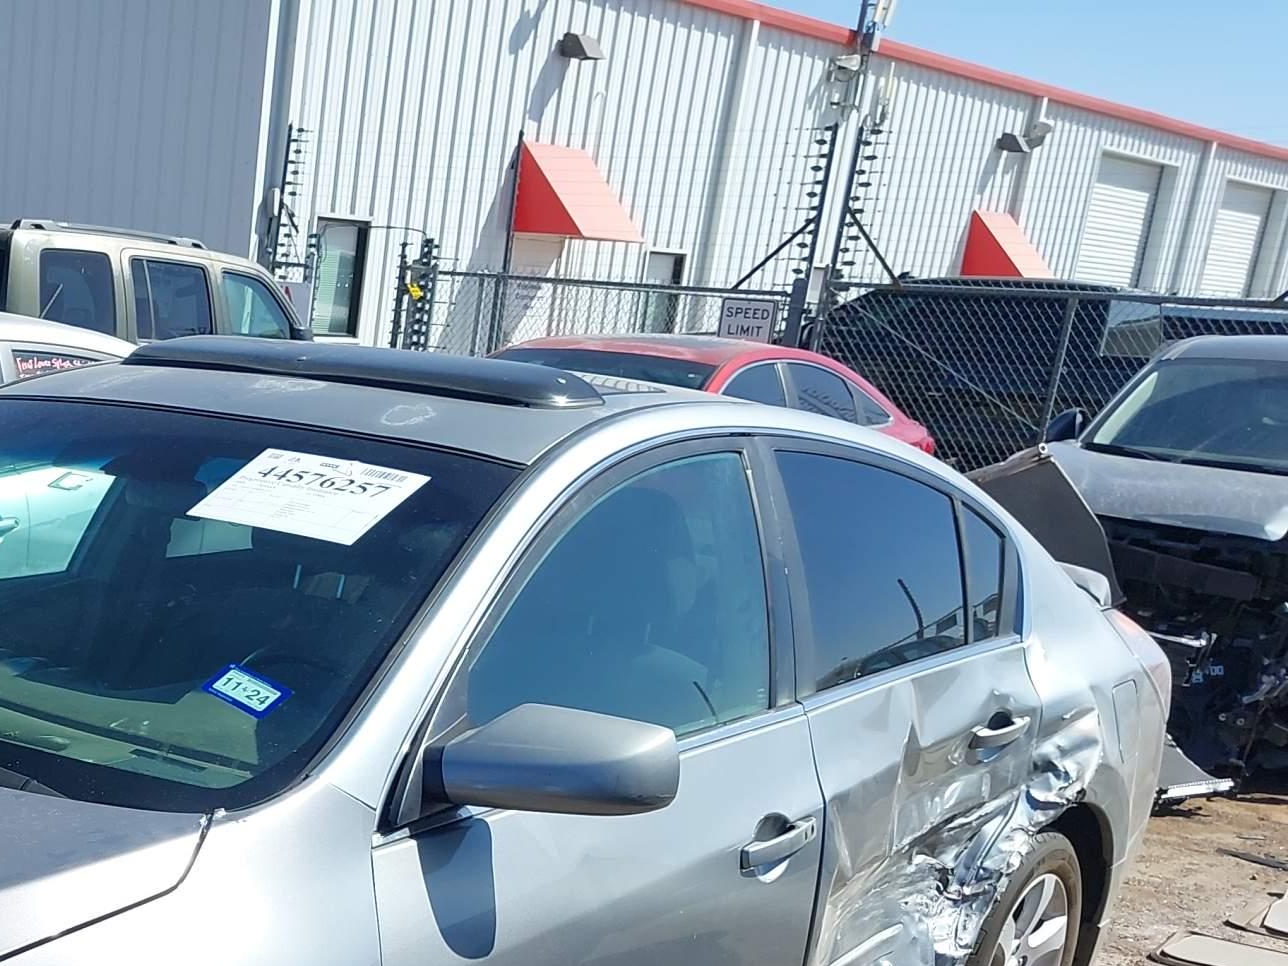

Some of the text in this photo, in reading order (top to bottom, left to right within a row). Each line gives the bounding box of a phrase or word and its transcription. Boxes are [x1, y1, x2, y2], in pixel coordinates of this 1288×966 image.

[725, 306, 770, 320] SPEED
[727, 323, 763, 337] LIMIT
[258, 466, 391, 498] 44576257
